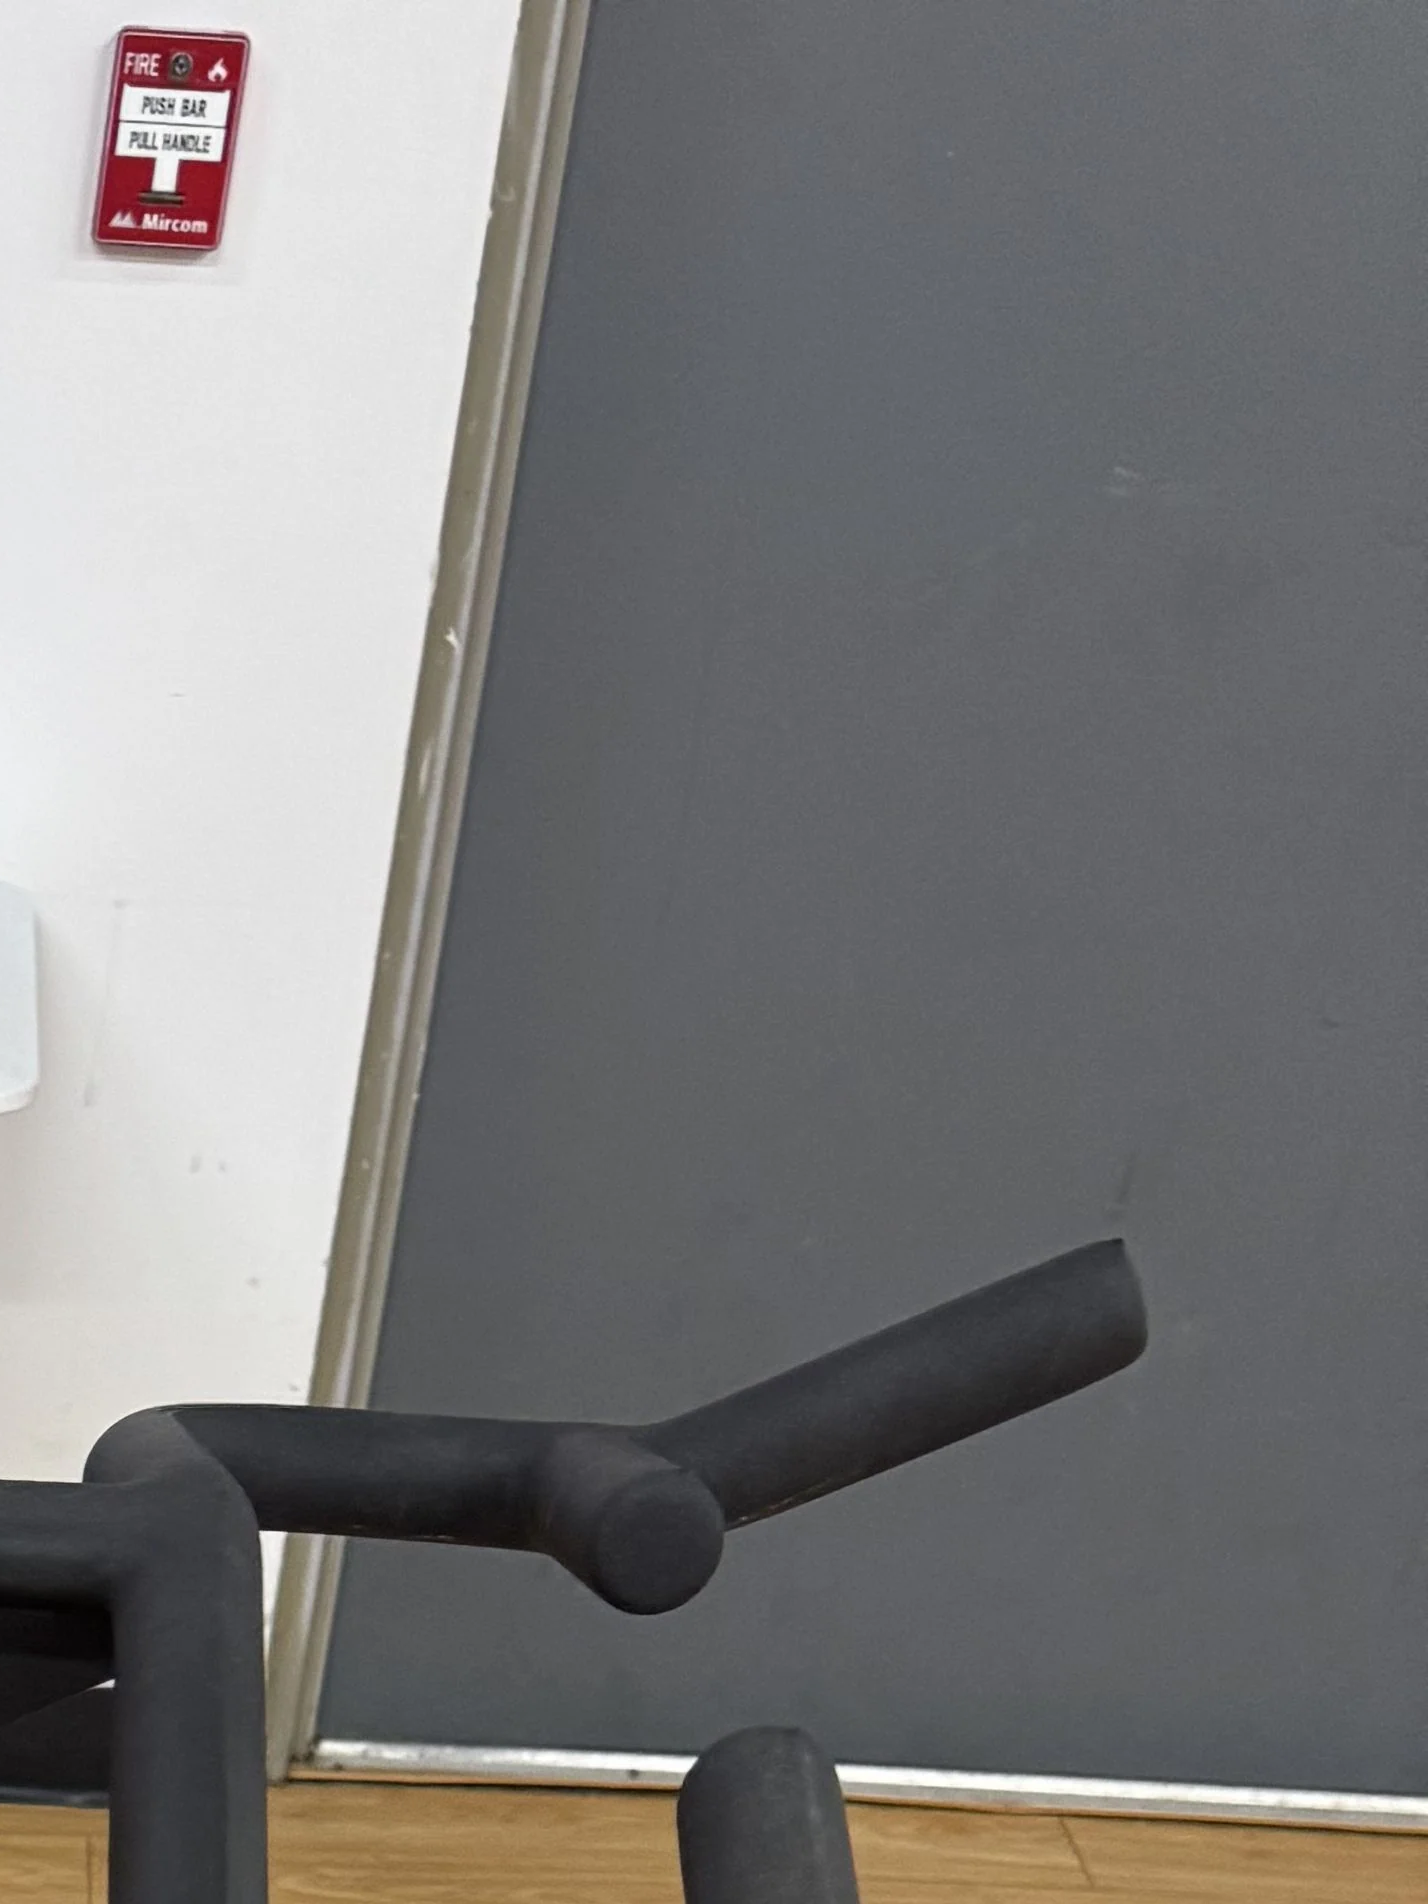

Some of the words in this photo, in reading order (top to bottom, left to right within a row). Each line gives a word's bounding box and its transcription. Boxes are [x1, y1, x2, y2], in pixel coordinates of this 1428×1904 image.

[123, 52, 161, 77] FIRE
[141, 96, 176, 116] PUSH
[180, 98, 207, 119] BAR
[128, 130, 159, 151] PULL
[161, 132, 212, 154] HANDLE
[141, 213, 208, 234] Mircom
